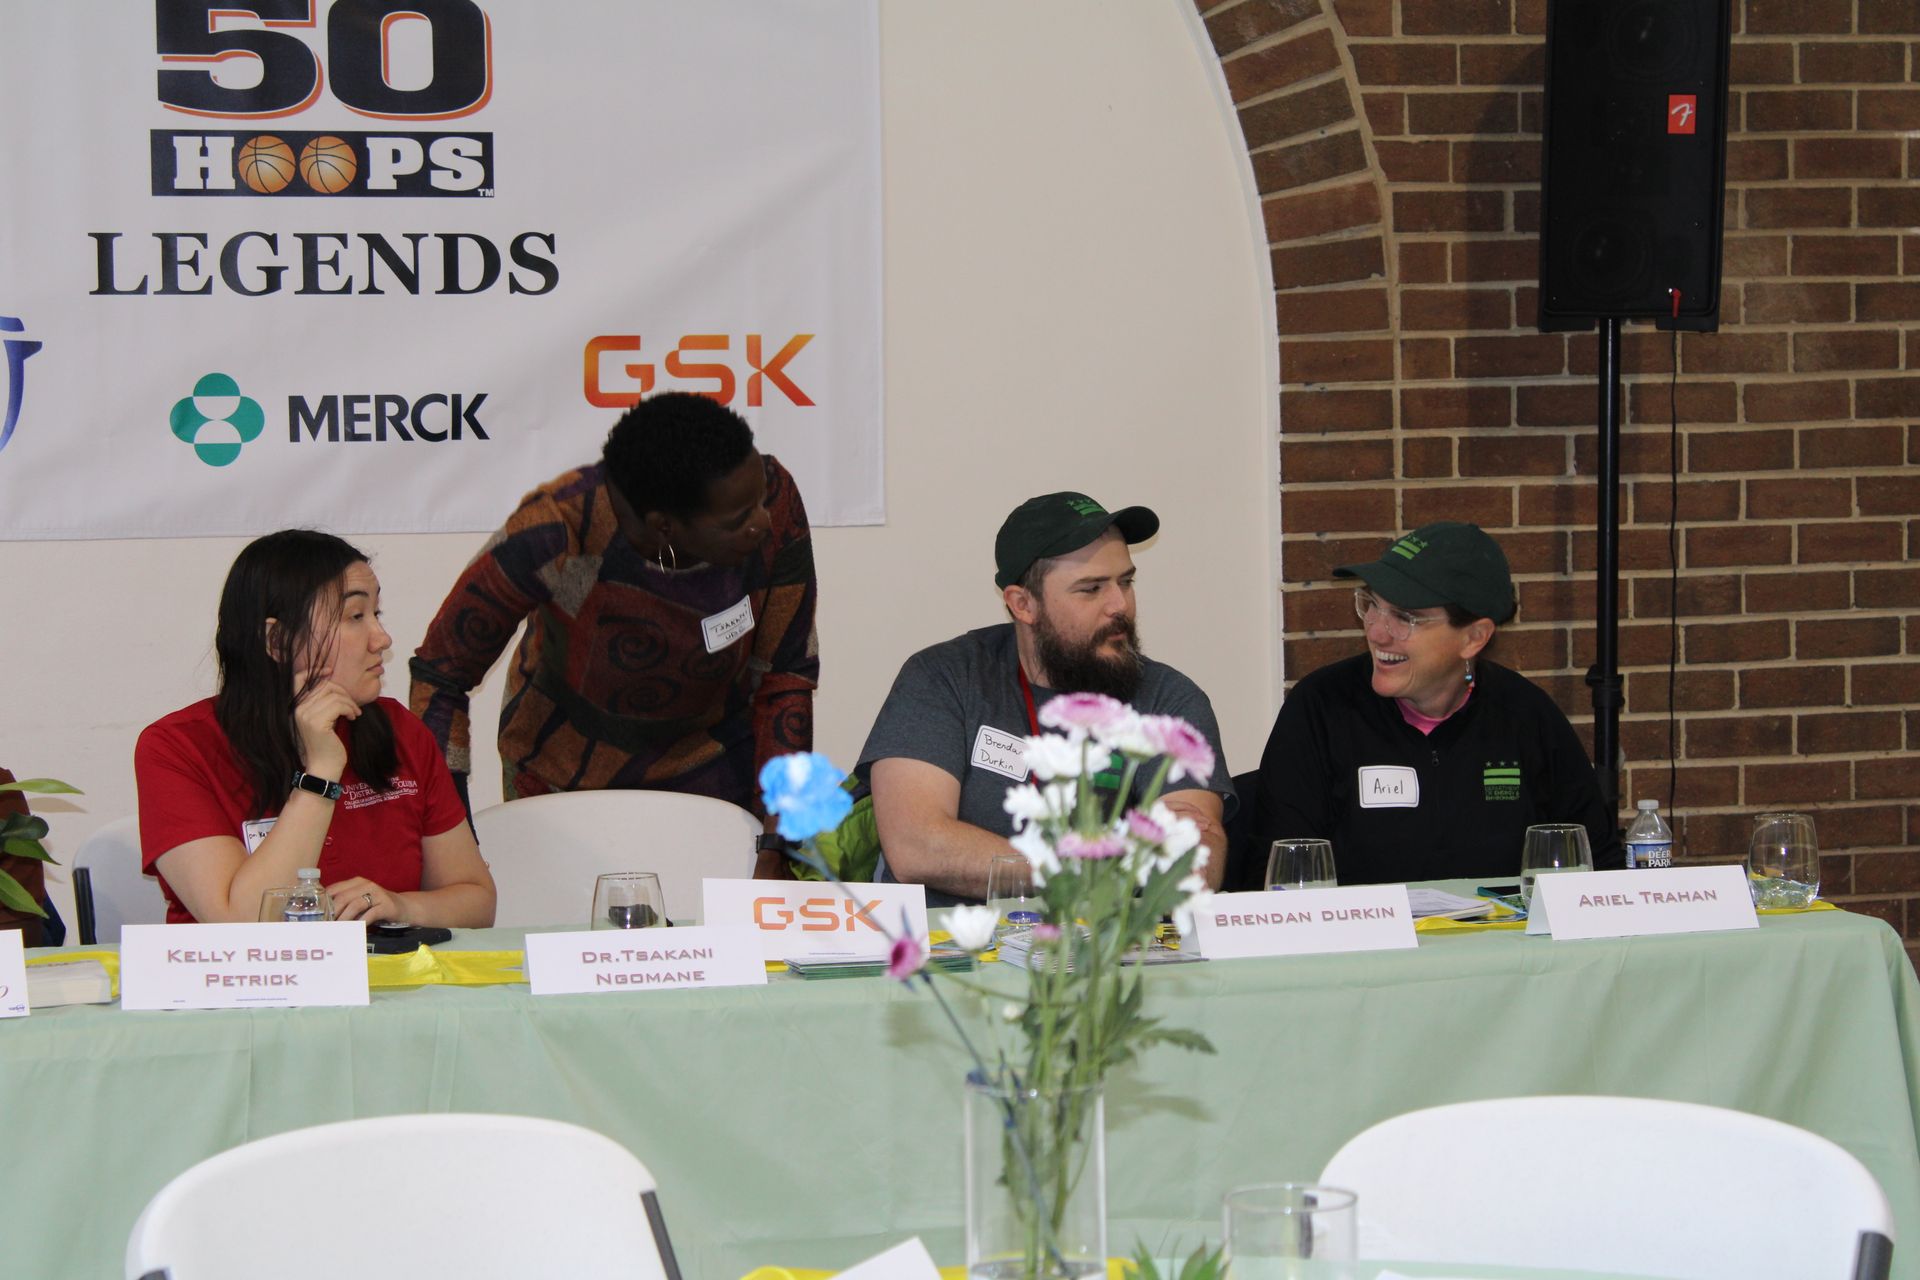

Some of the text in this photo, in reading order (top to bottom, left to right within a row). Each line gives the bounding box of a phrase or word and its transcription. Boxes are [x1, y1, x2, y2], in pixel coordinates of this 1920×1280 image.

[156, 0, 493, 121] 50
[88, 231, 560, 297] LEGENDS
[584, 334, 816, 408] GSK
[288, 393, 490, 443] MERCK
[981, 749, 1014, 771] Durkin
[1374, 777, 1404, 795] Ariel
[1647, 858, 1671, 868] PARK
[1648, 849, 1672, 859] DEER
[1578, 889, 1718, 909] ARIEL TRAHAN
[753, 896, 882, 931] GSK
[596, 970, 705, 985] NGOMANE
